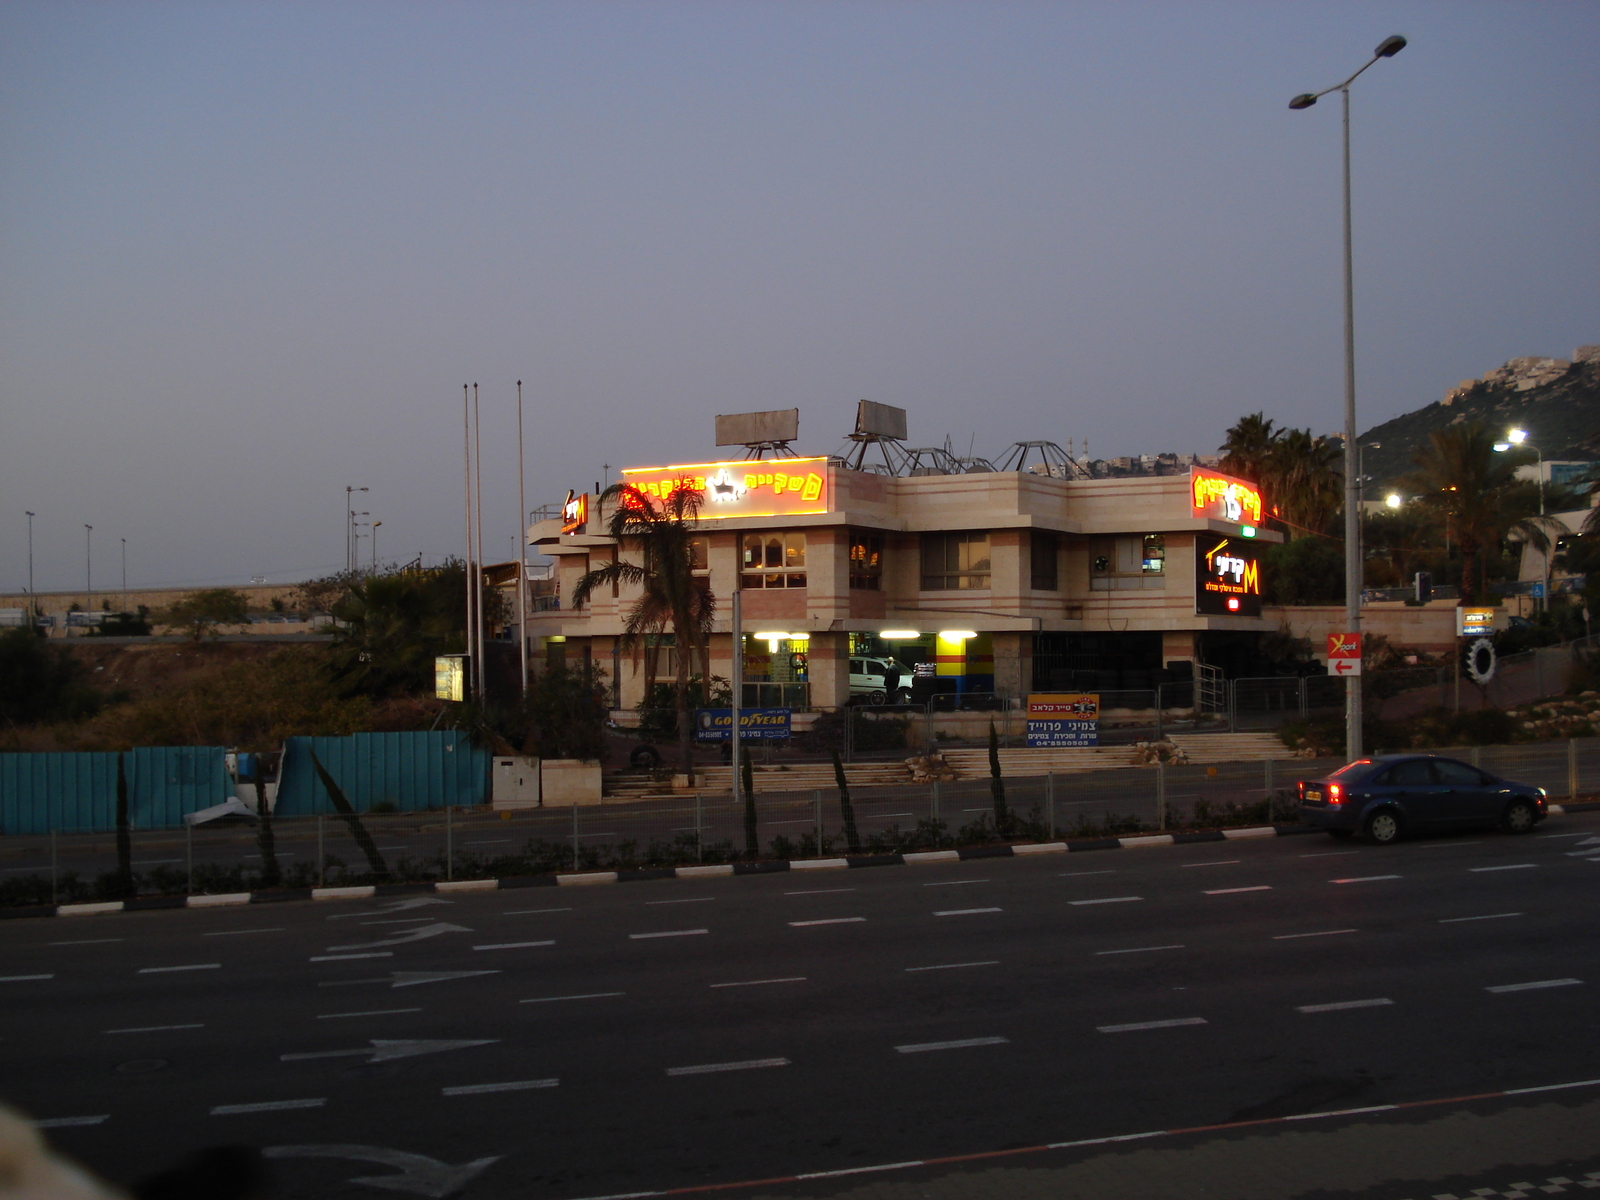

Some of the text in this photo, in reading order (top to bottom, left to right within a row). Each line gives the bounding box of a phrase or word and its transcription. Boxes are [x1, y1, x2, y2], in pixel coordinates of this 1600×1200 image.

[714, 714, 786, 726] GODYEAR
[1028, 722, 1096, 731] צמיגי פרוייד
